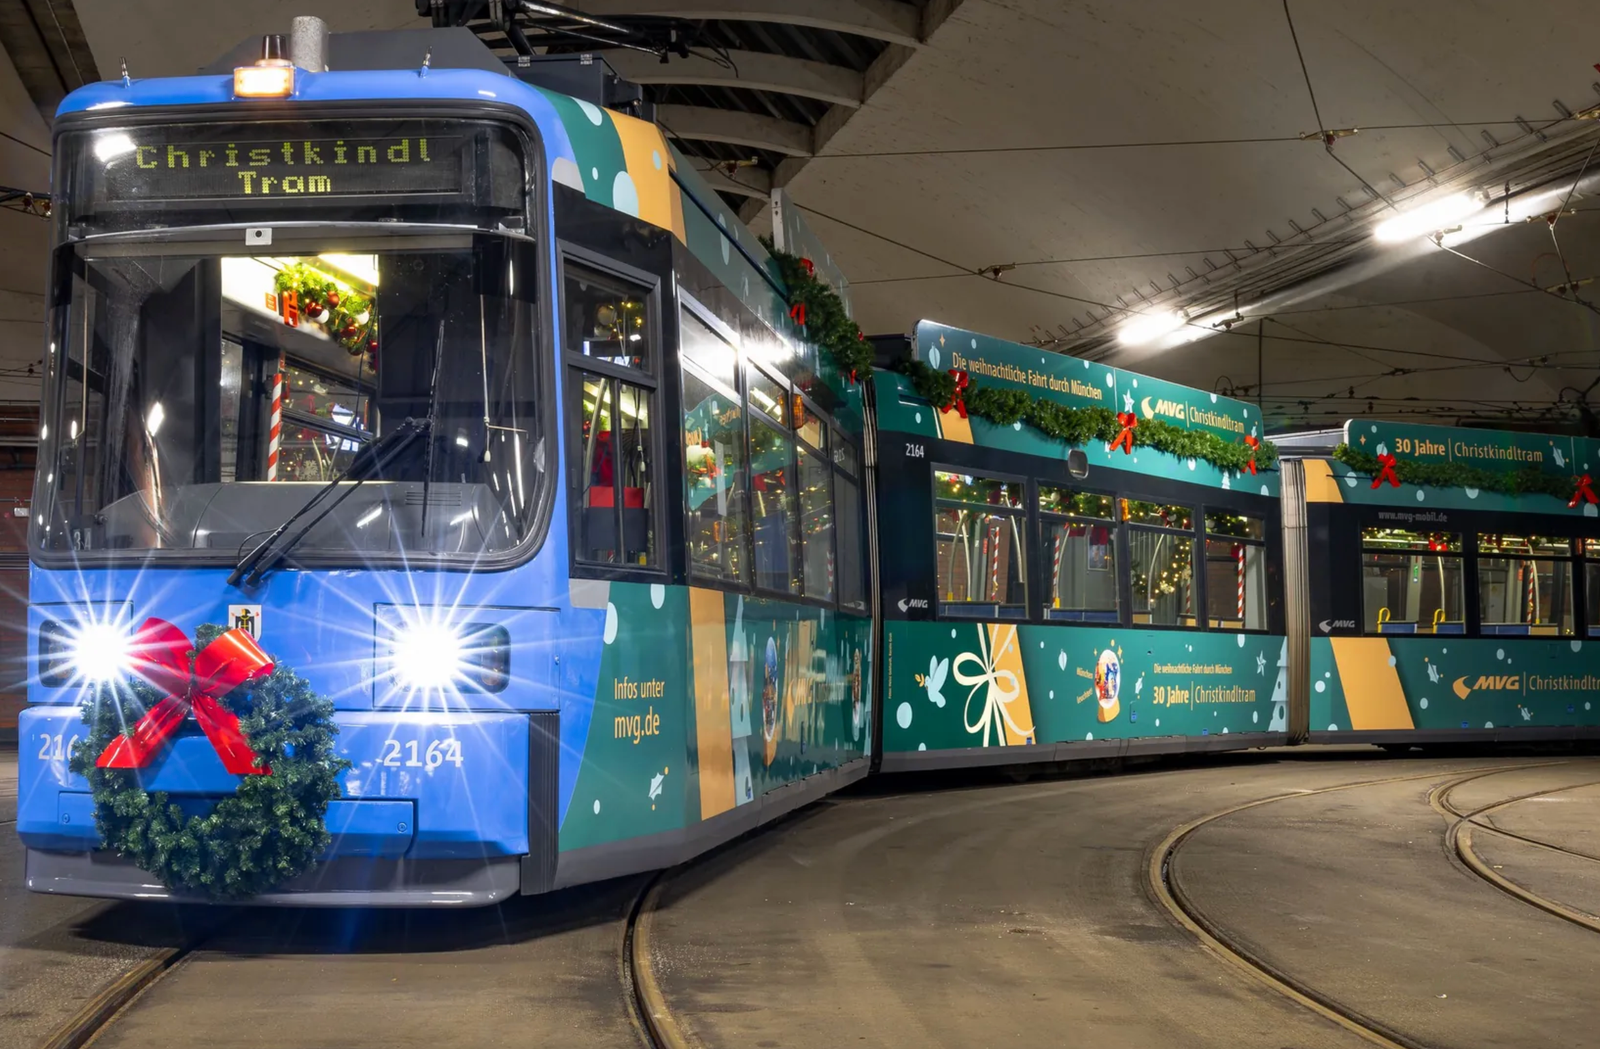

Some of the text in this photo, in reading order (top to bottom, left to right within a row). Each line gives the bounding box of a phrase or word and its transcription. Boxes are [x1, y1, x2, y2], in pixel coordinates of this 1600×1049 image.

[136, 138, 430, 168] Christkindl
[238, 171, 331, 194] Tram
[952, 351, 1103, 401] Die weihnachtliche Fahrt durch München
[1155, 399, 1245, 434] MVG Christkindltram
[905, 443, 925, 459] 2164
[1395, 438, 1543, 462] 30 Jahre Christkindltram
[1378, 511, 1448, 523] www.mvg-mobil.de
[908, 598, 928, 609] MVG
[1332, 620, 1356, 628] MVG
[614, 676, 665, 700] Infos unter
[1472, 675, 1520, 690] MVG
[1153, 684, 1256, 708] 30 Jahre Christkindltram
[614, 705, 660, 745] mvg.de
[38, 733, 80, 762] 216
[383, 739, 464, 768] 2164
